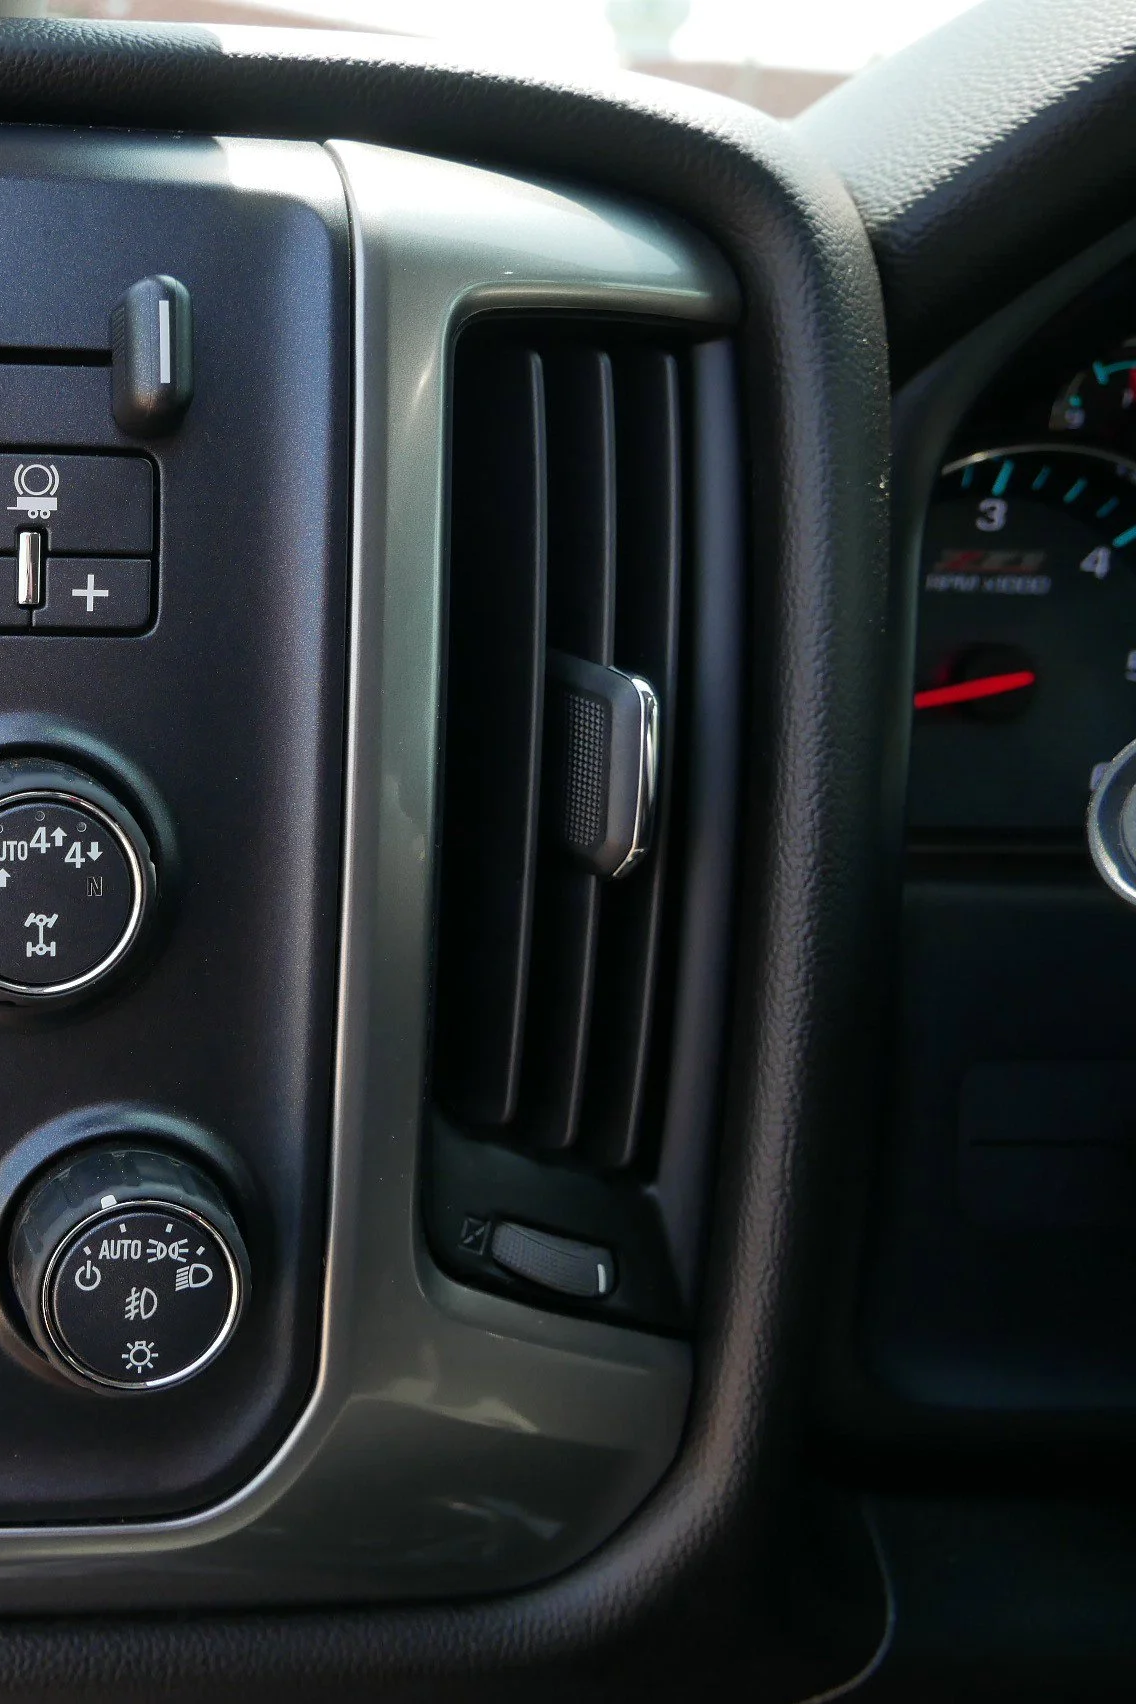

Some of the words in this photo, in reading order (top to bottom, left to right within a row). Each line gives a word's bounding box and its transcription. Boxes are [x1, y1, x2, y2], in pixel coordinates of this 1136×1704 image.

[975, 498, 1007, 531] 3
[1079, 546, 1110, 579] 4
[30, 826, 51, 854] 4
[64, 841, 85, 869] 4
[86, 876, 103, 897] N
[98, 1240, 142, 1260] AUTO
